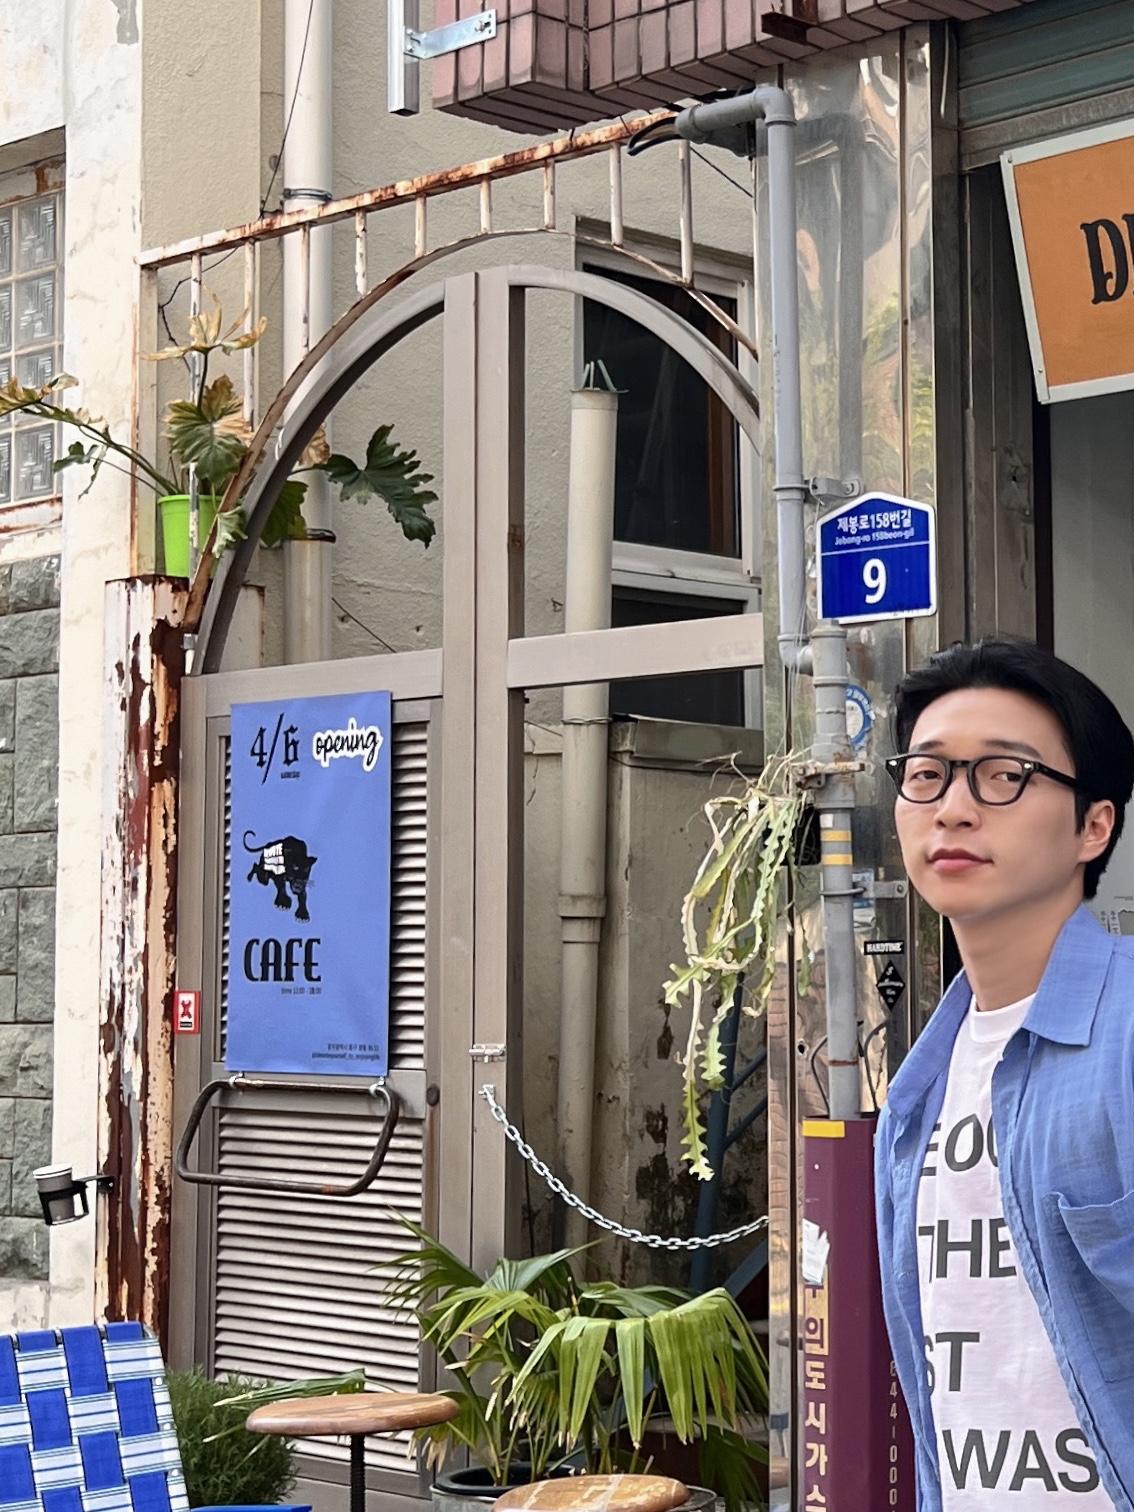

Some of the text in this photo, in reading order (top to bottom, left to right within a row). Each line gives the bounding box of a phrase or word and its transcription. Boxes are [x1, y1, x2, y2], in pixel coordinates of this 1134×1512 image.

[836, 508, 912, 535] 제봉로158번길
[862, 558, 887, 605] 9
[250, 712, 379, 785] 4/6 opening
[243, 938, 322, 982] CAFE
[942, 1428, 1100, 1493] WAS
